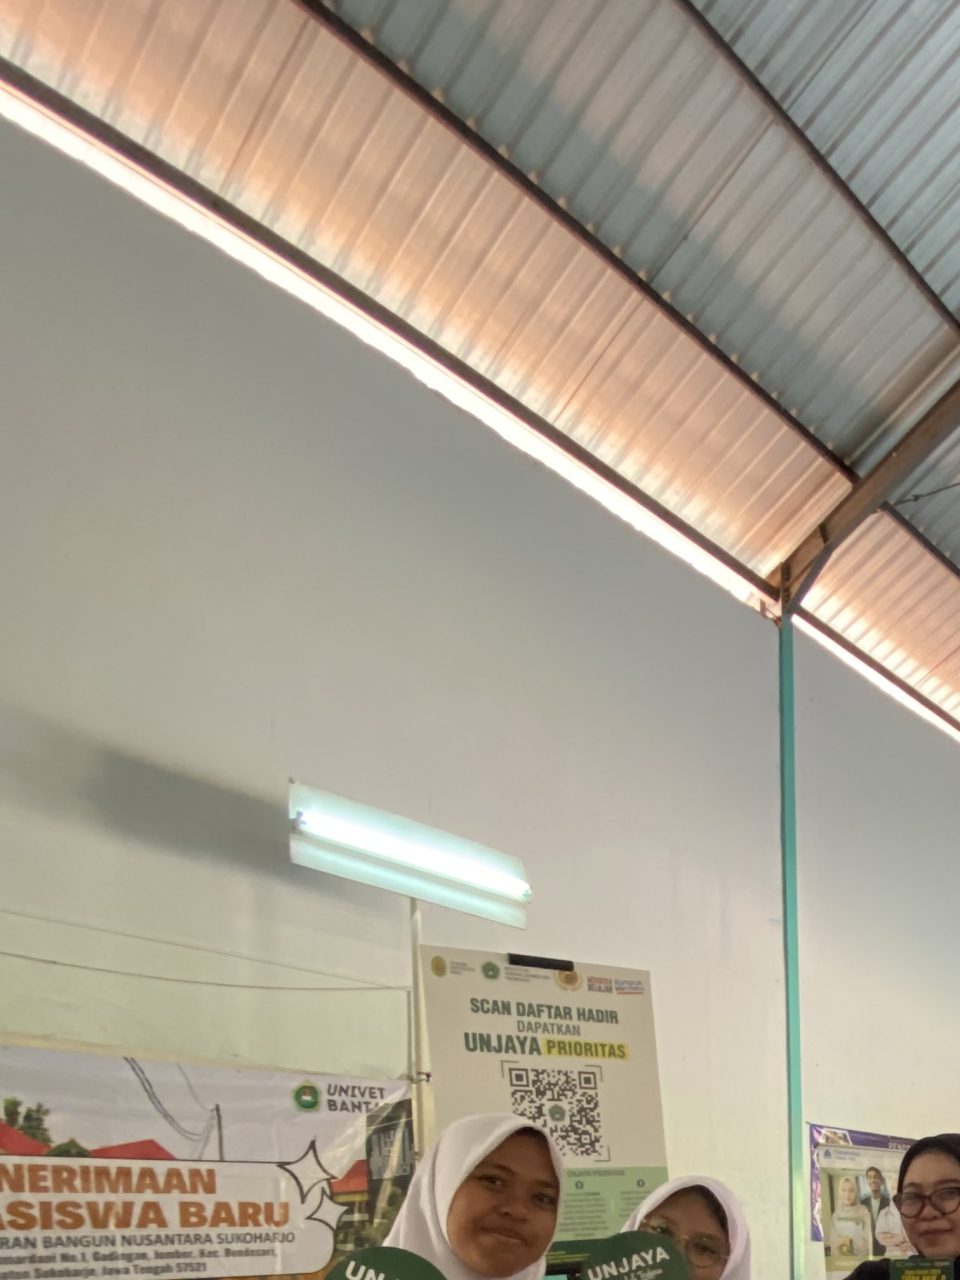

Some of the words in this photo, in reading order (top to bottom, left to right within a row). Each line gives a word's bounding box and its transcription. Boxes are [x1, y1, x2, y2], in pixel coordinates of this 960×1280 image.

[470, 998, 511, 1015] SCAN
[516, 1002, 572, 1020] DAFTAR
[576, 1008, 619, 1024] HADIR
[517, 1020, 581, 1036] DAPATKAN
[463, 1032, 542, 1055] UNJAYA
[546, 1039, 626, 1059] PRIORITAS
[327, 1083, 386, 1100] UNIVET
[0, 1201, 168, 1231] SISWA
[179, 1202, 290, 1228] BARU
[43, 1234, 116, 1248] BANGUN
[121, 1232, 214, 1246] NUSANTARA
[217, 1231, 296, 1244] SUKOHARJO
